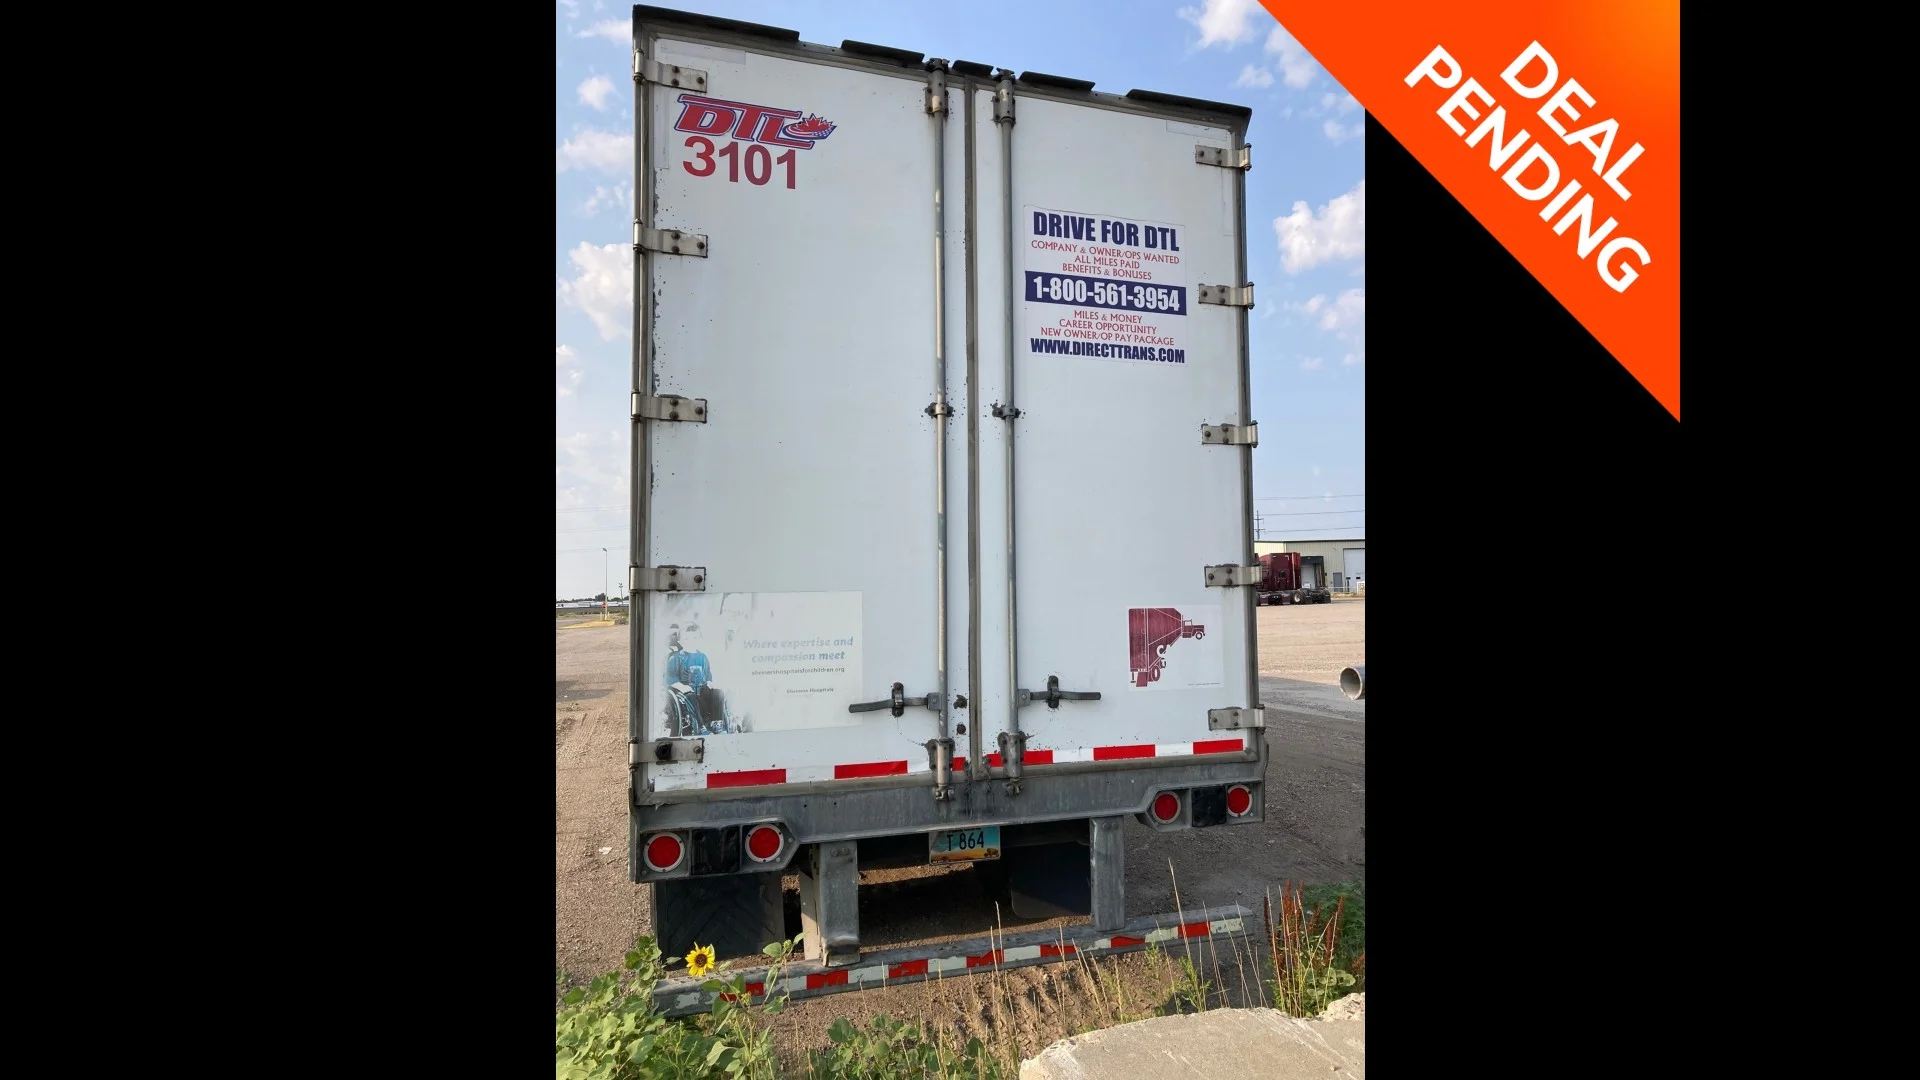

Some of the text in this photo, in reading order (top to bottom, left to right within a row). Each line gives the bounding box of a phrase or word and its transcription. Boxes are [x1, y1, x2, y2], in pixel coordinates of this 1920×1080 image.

[673, 93, 816, 150] DTL
[682, 135, 796, 190] 3101
[1033, 211, 1180, 252] DRIVE FOR DTL
[1031, 240, 1180, 265] COMPANY & OWNER/OPS WANTED
[1074, 255, 1140, 269] ALL MILES PAID
[1062, 262, 1102, 275] BENEFITS
[1112, 268, 1152, 281] BONUSES
[1033, 276, 1180, 312] 1-800-561-3954
[1059, 318, 1157, 335] CAREER OPPORTUNITY
[1074, 310, 1143, 324] MILES & MONEY
[1040, 327, 1175, 346] NEW OWNER/OP PAY PACKAGE
[1030, 337, 1185, 364] WWW.DIRECTTRANS.COM
[743, 636, 854, 650] Where expertise and
[751, 651, 846, 664] compassion meet
[959, 831, 984, 849] 864
